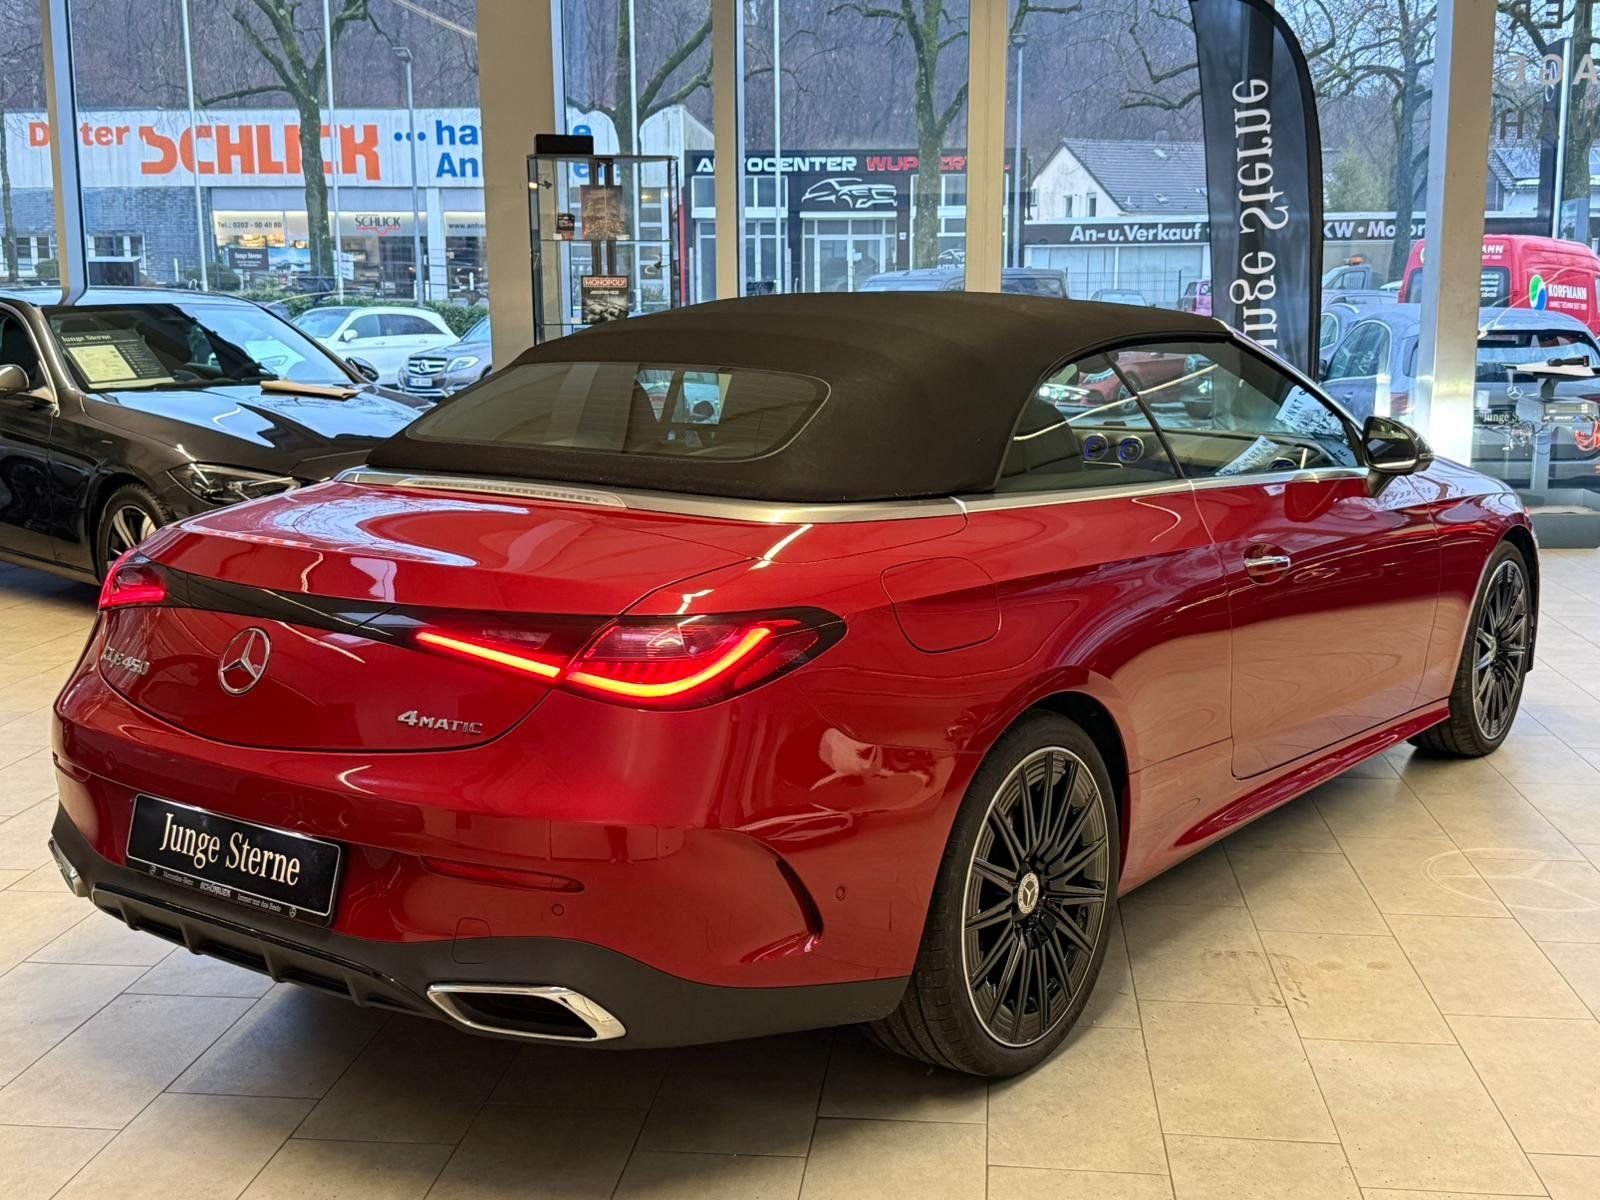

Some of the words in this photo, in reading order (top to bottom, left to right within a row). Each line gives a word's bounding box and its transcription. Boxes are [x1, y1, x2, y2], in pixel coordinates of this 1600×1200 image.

[28, 122, 130, 147] Dter
[696, 156, 857, 172] AOCENTER
[355, 216, 400, 227] SCHLICK
[1548, 284, 1587, 299] KORFMANN
[397, 710, 484, 735] 4MATIC
[159, 812, 221, 869] Junge
[224, 831, 301, 886] Sterne
